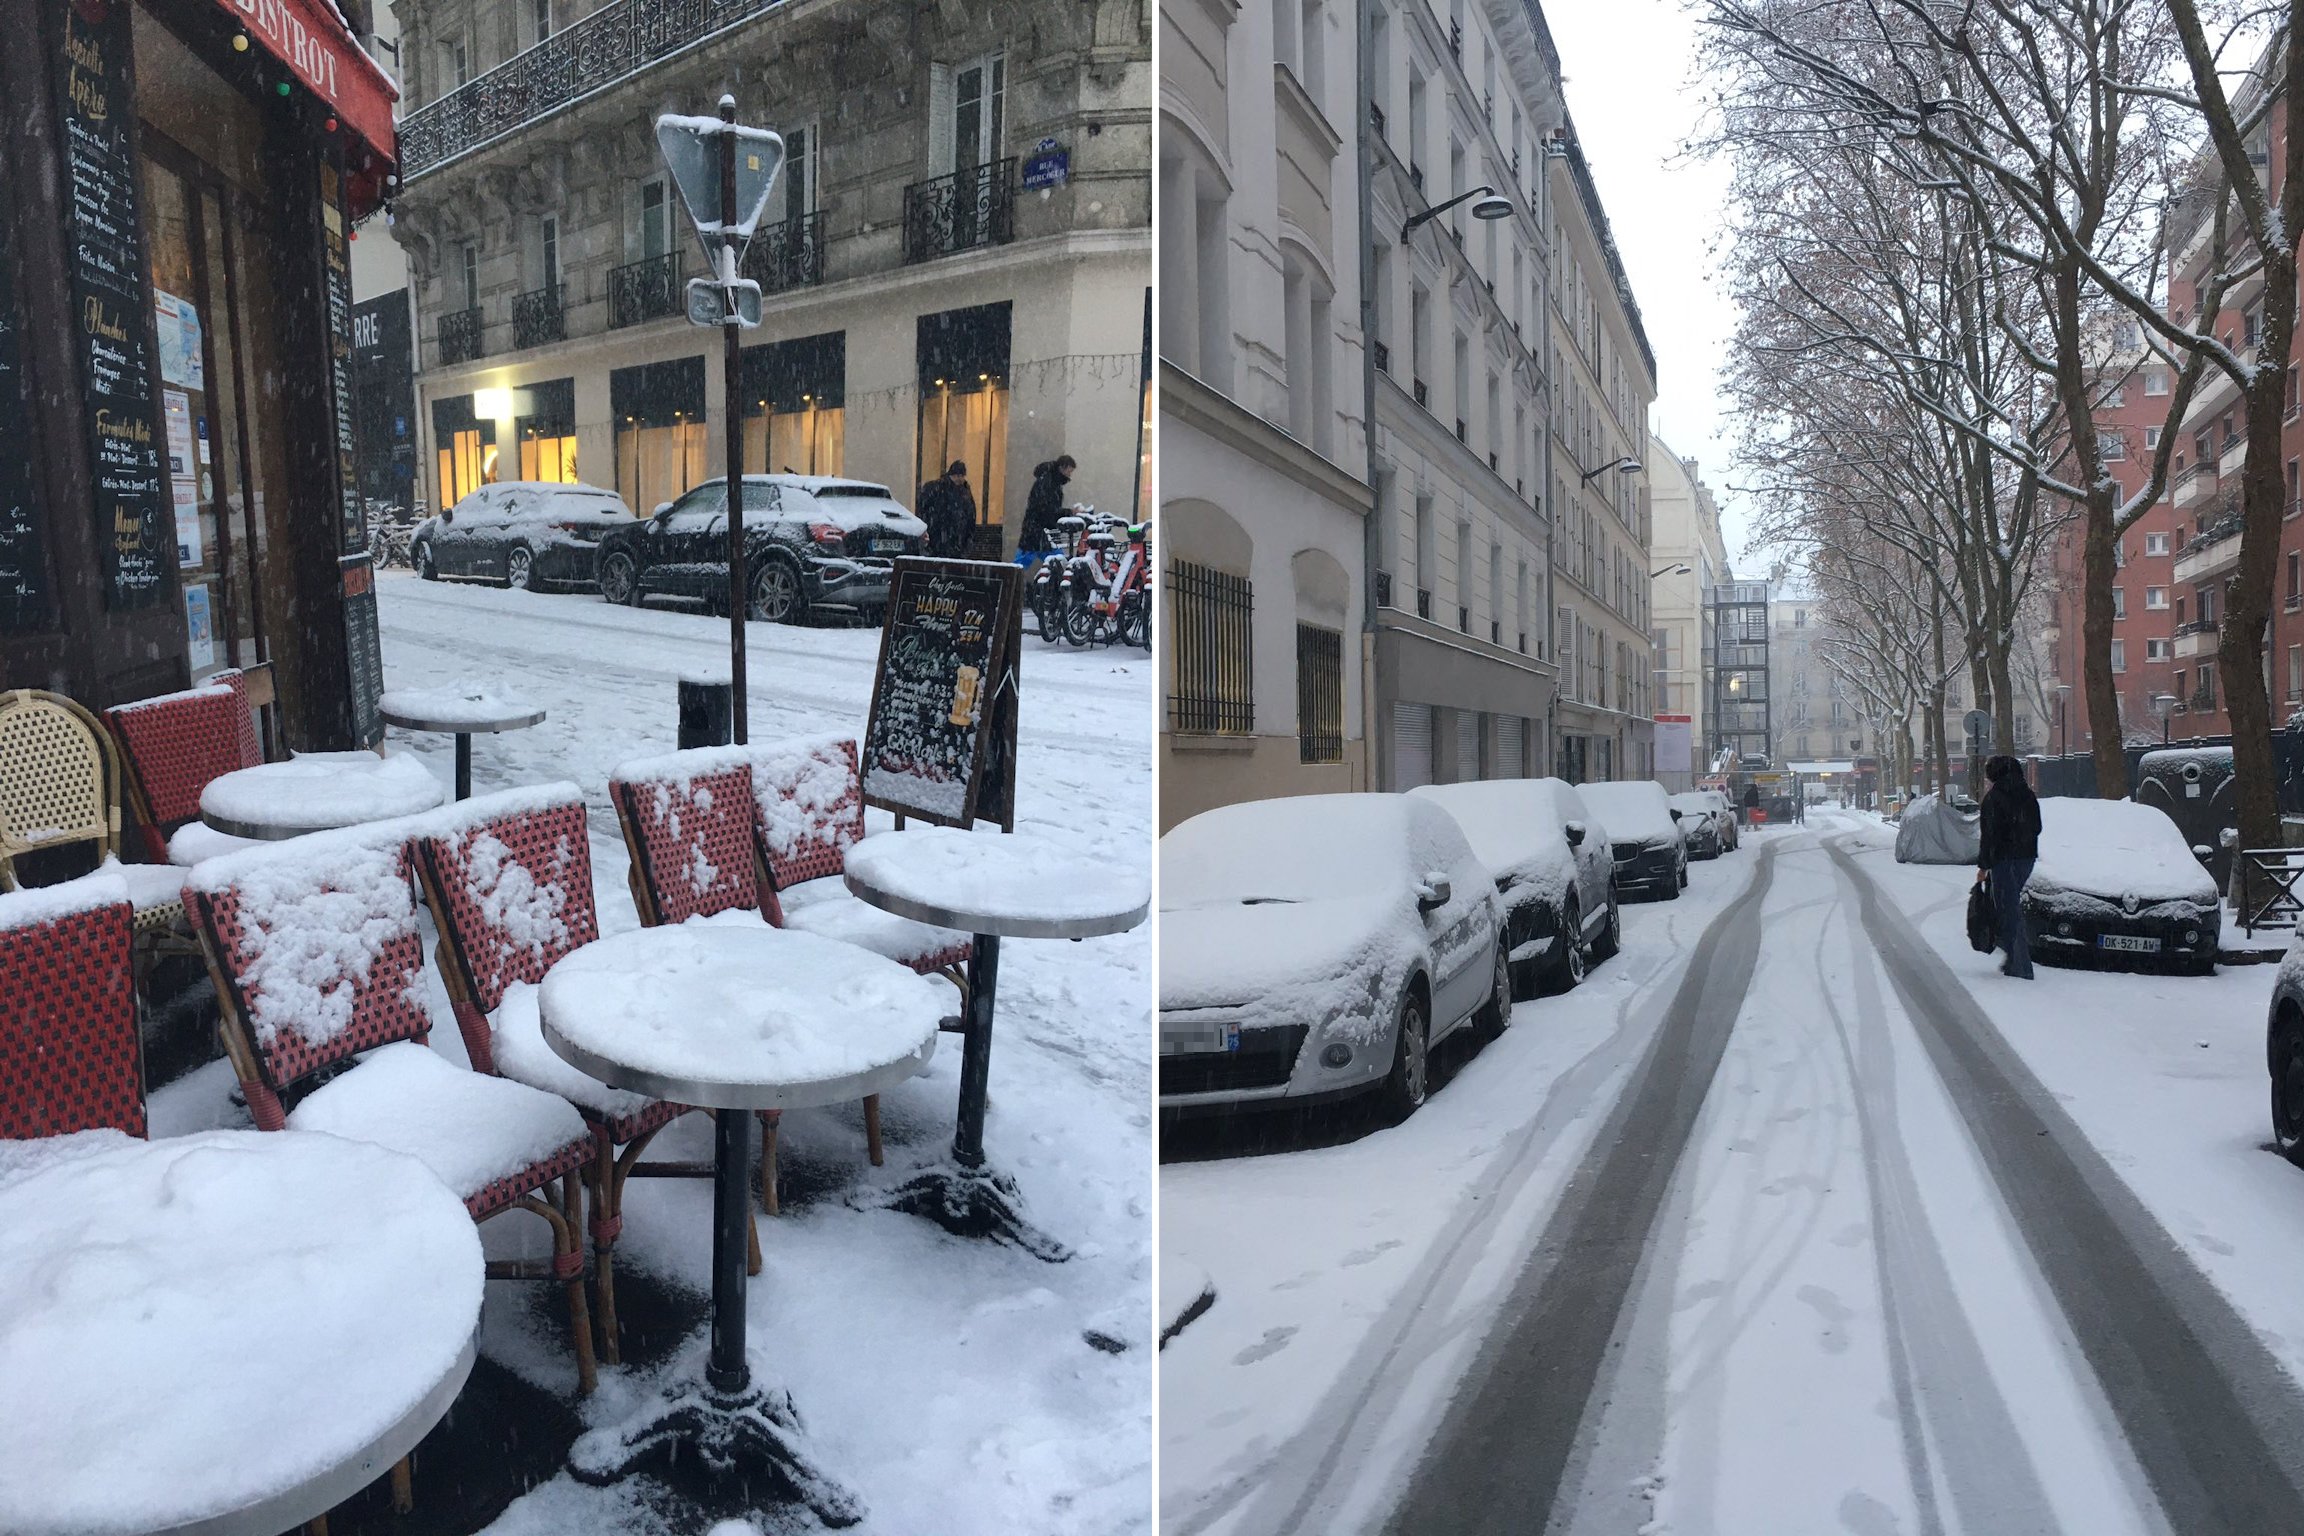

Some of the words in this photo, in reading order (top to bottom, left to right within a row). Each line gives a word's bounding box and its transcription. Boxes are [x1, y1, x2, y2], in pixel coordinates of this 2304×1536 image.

[236, 0, 337, 98] ISTROT
[354, 312, 379, 349] RRE
[915, 593, 958, 617] HAPPY
[1228, 1036, 1239, 1048] 75
